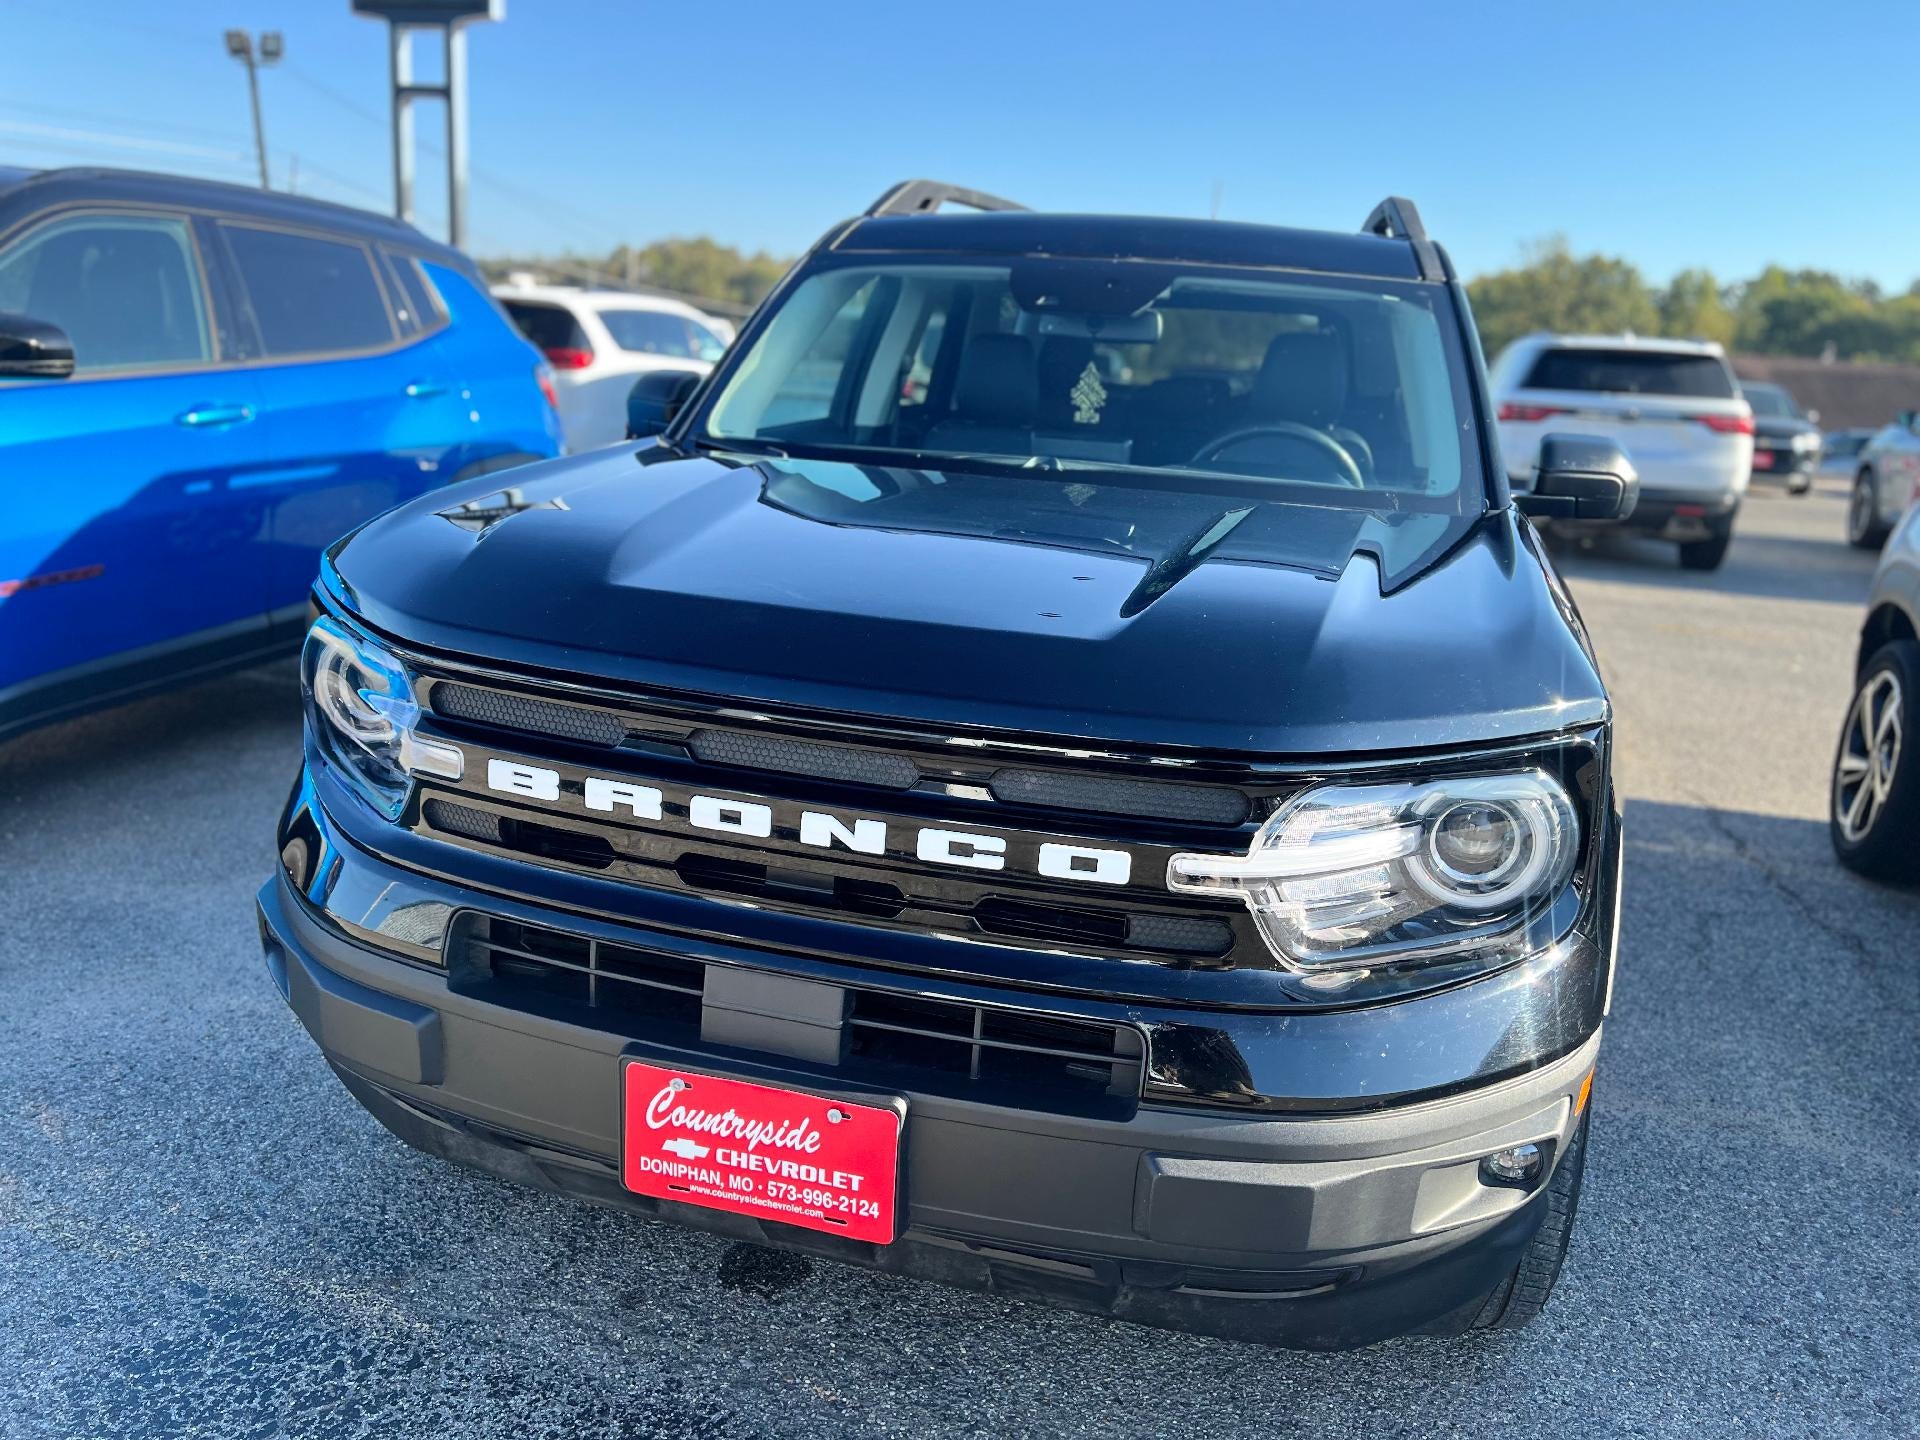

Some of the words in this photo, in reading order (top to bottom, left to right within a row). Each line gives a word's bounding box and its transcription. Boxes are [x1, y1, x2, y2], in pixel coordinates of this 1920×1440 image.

[487, 758, 1132, 885] BRONCO
[645, 1086, 821, 1154] Countryside
[639, 1155, 724, 1188] DONIPHAN,
[728, 1175, 753, 1192] MO
[767, 1182, 879, 1219] 573-996-2124
[689, 1184, 824, 1219] www.countrysidechevrolet.com
[715, 1148, 864, 1191] CHEVROLET
